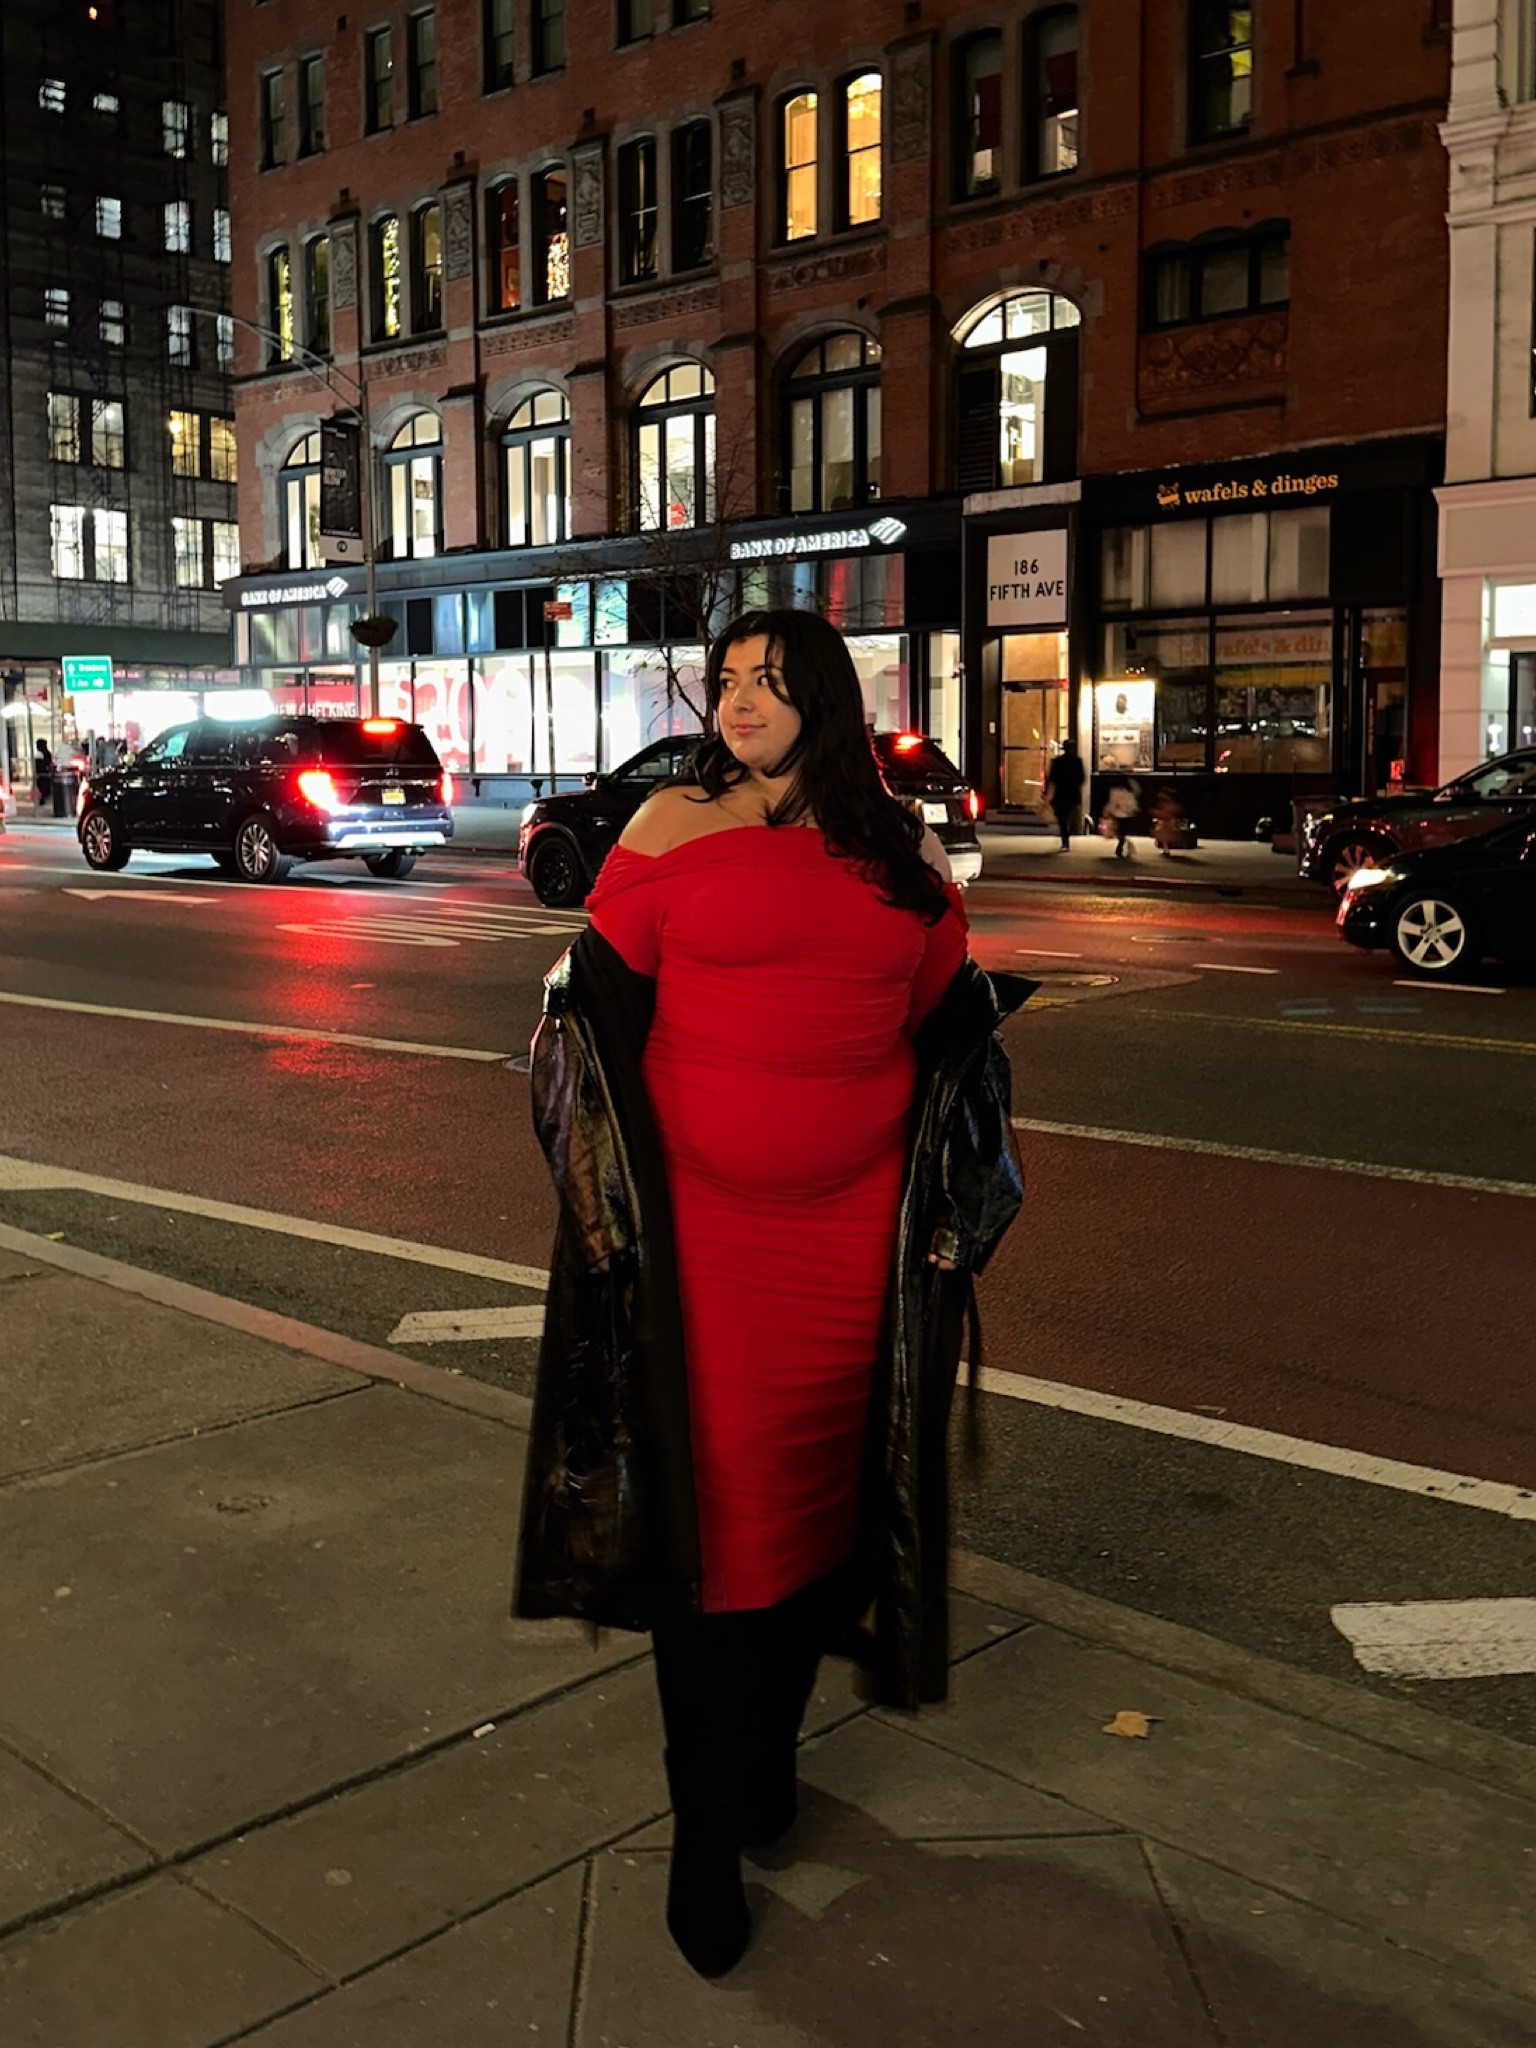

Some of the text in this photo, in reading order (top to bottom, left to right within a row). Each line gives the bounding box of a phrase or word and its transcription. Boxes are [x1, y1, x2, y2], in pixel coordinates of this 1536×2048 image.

[1184, 474, 1339, 504] wafels & dinges
[730, 528, 870, 560] BANK OF AMERICA
[1014, 559, 1040, 576] 186
[241, 590, 268, 606] BANK
[281, 585, 327, 602] AMERICA
[990, 580, 1064, 601] FIFTH AVE
